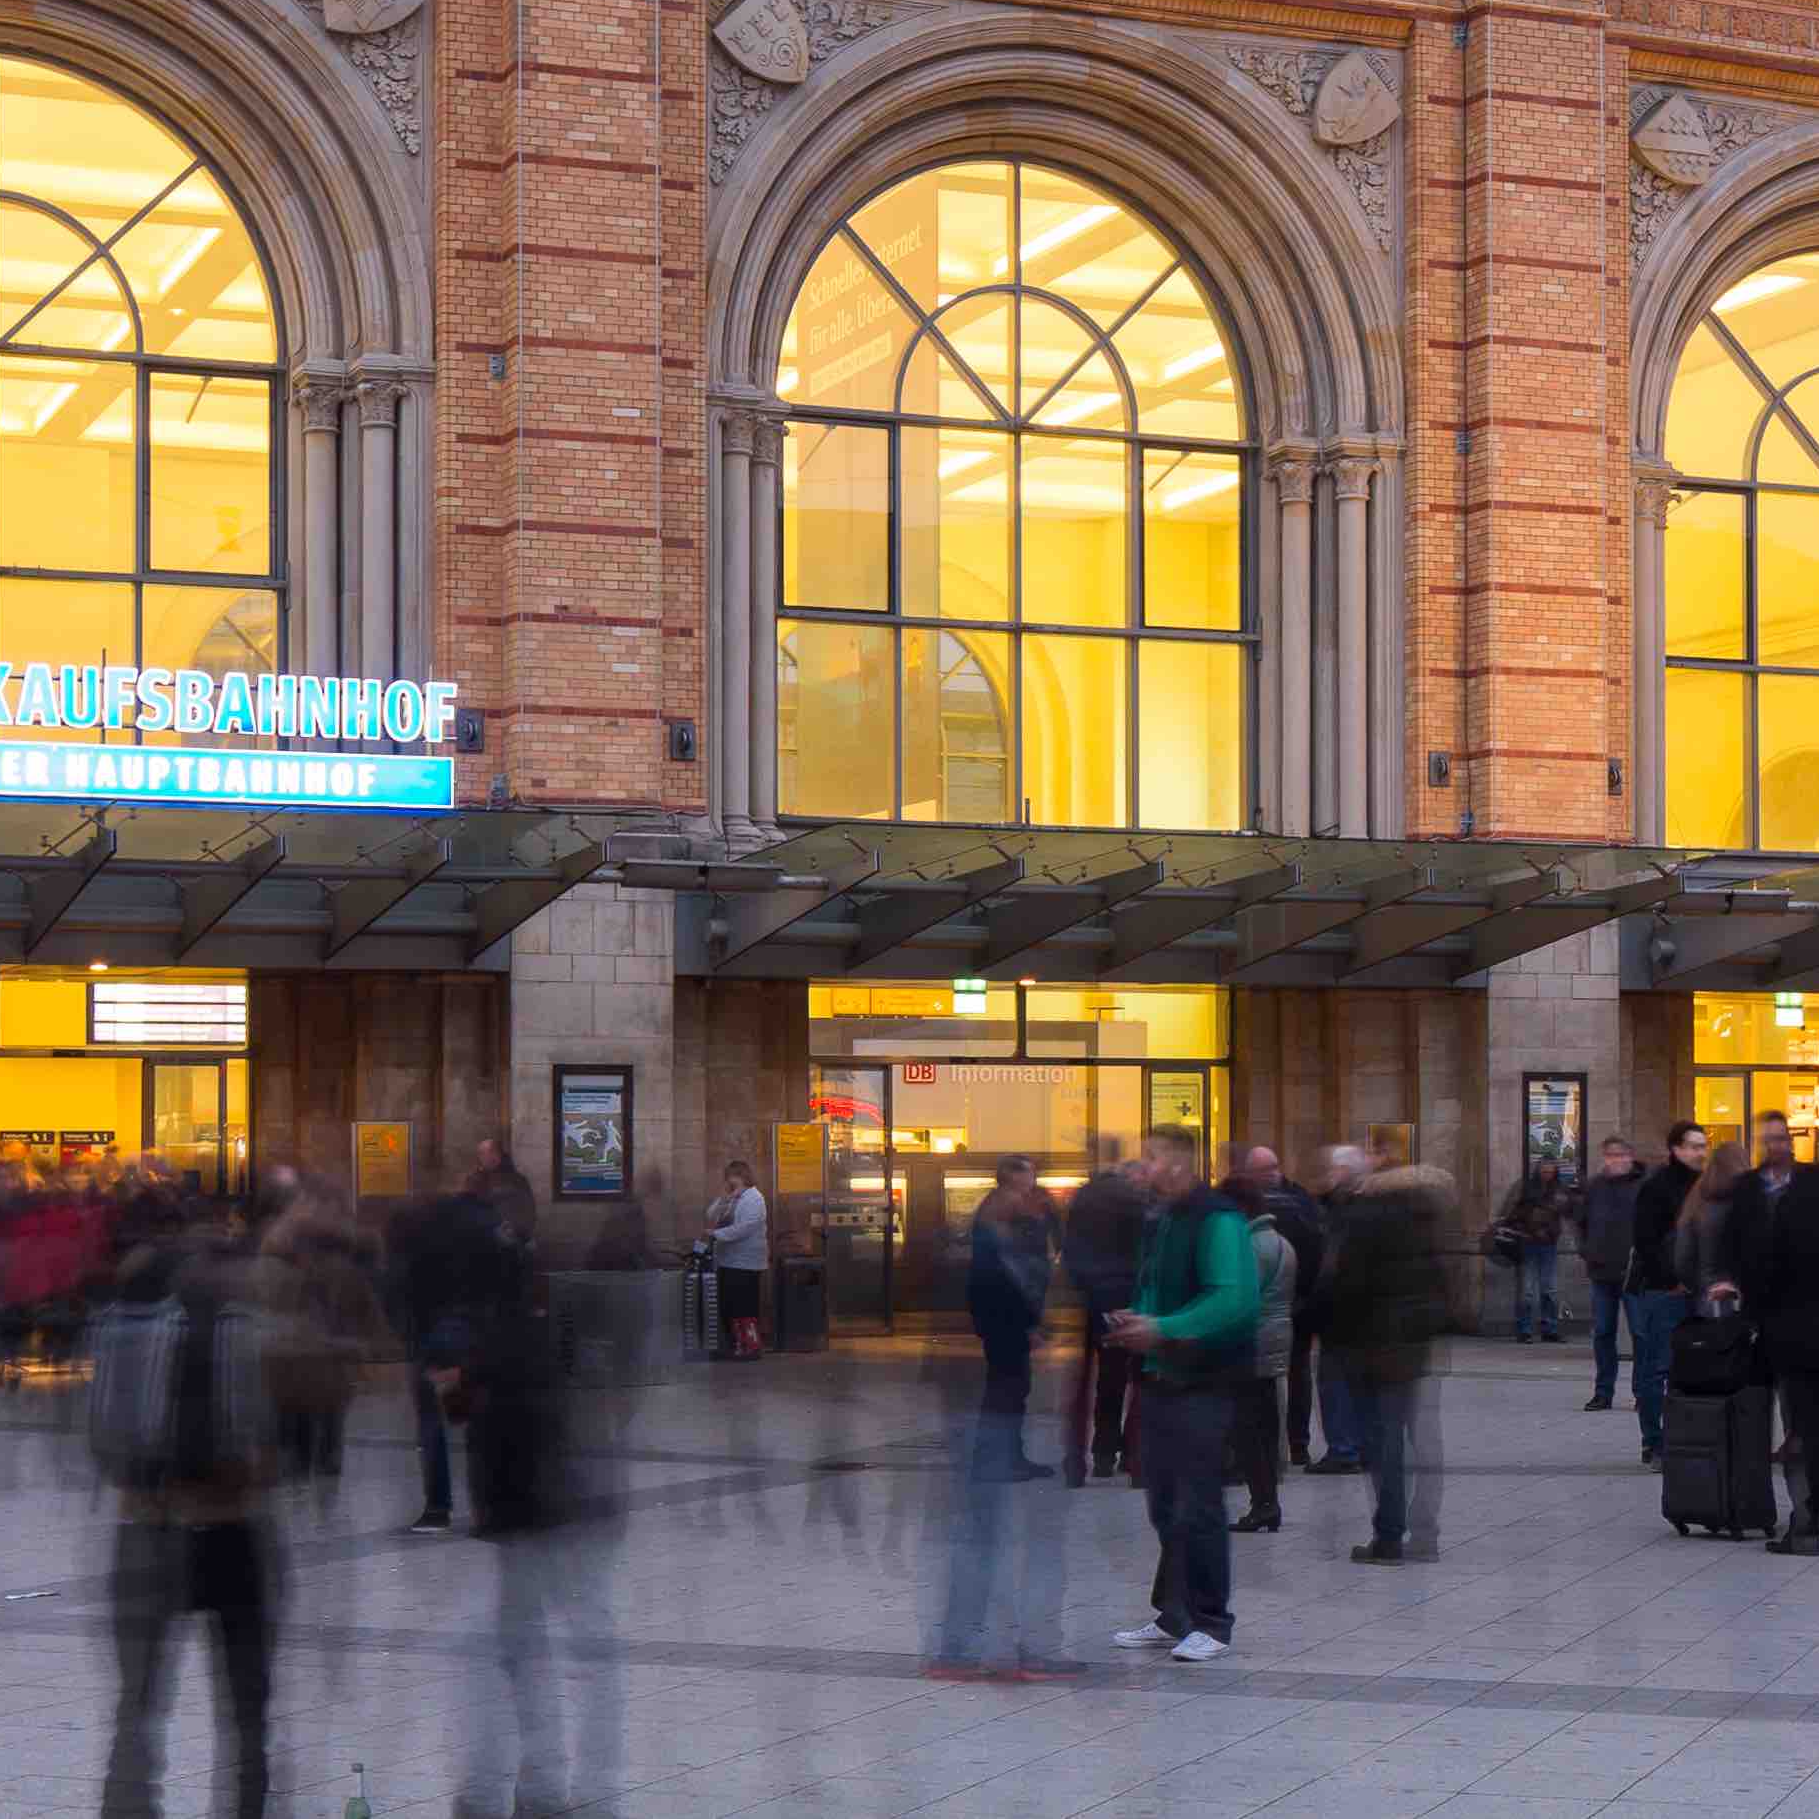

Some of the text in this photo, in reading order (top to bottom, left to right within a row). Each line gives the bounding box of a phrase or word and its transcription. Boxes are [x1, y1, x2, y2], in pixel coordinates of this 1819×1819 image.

[868, 221, 923, 277] ternet
[65, 753, 377, 797] HAUPTBAHNHOF
[907, 1064, 1077, 1084] DB Information
